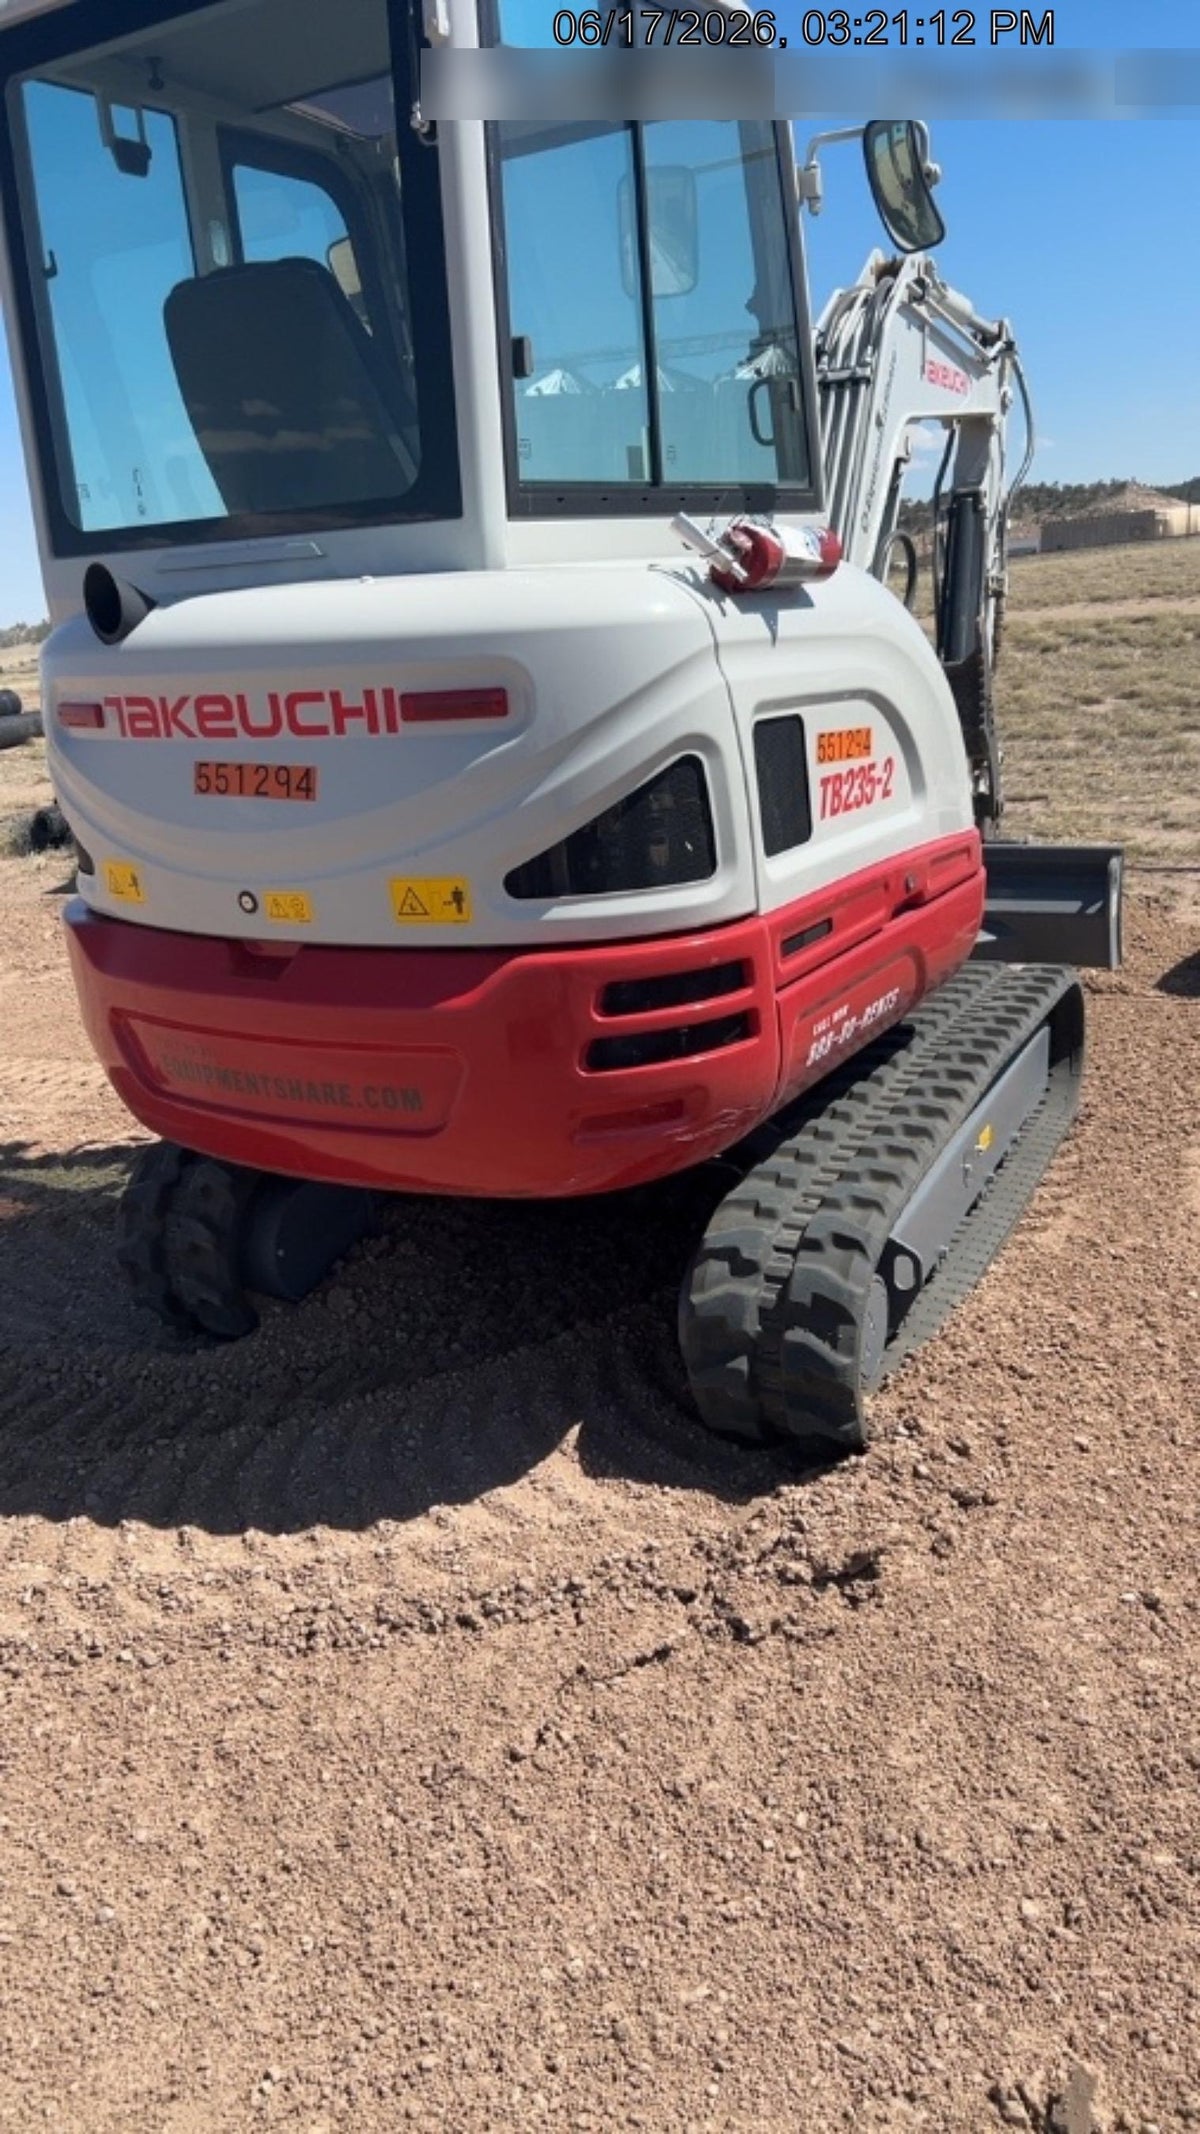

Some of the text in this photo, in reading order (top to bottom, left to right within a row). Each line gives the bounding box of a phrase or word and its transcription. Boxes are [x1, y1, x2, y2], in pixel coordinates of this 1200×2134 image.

[818, 728, 871, 764] 551294
[194, 761, 314, 799] 551294
[820, 756, 894, 820] TB235-2
